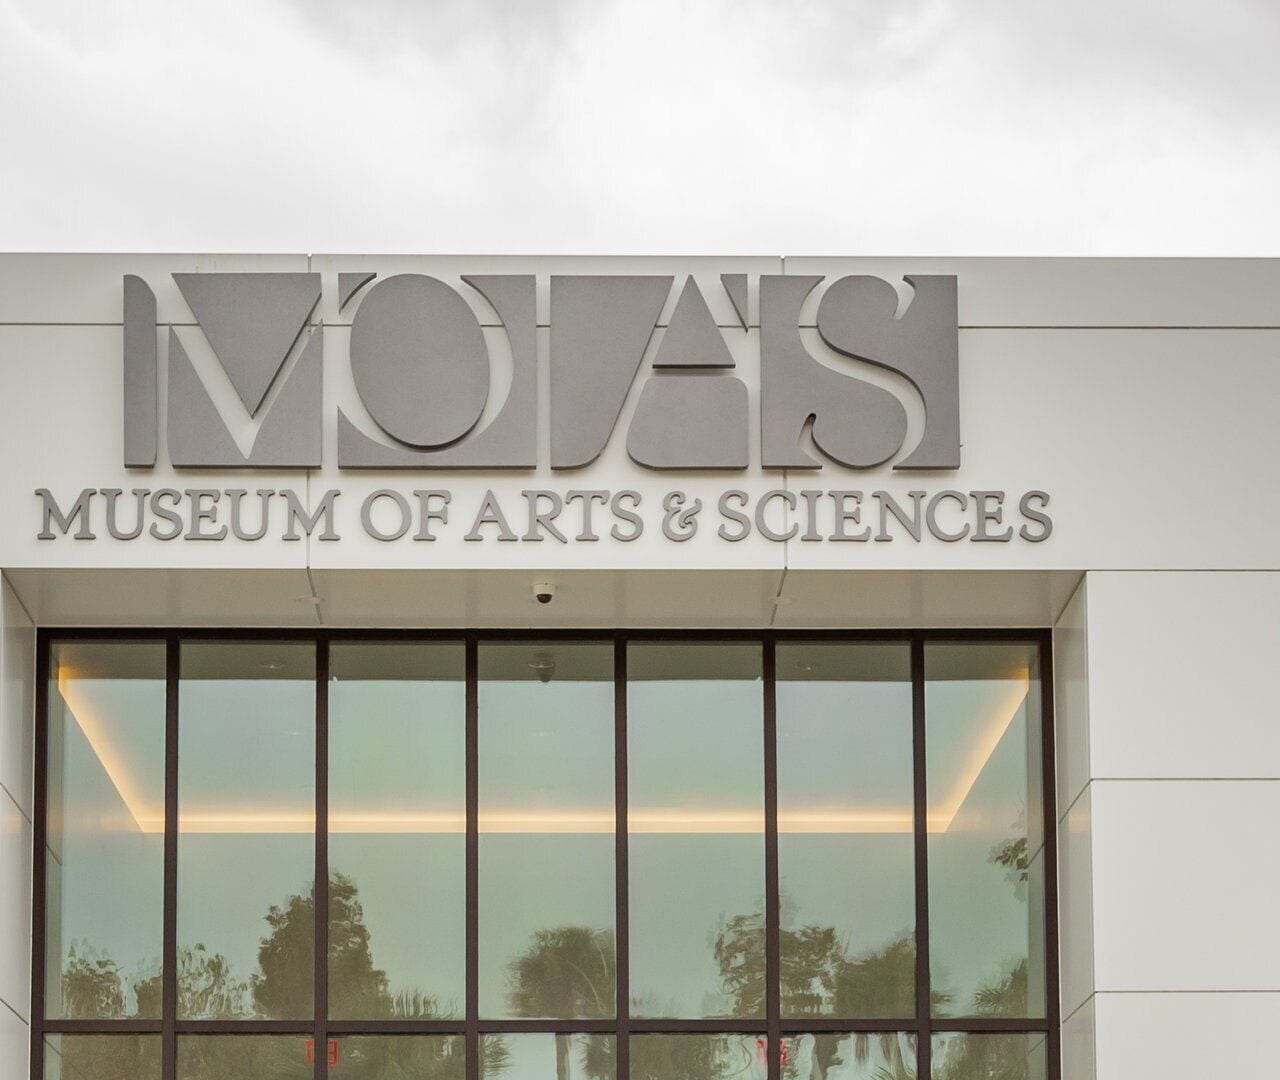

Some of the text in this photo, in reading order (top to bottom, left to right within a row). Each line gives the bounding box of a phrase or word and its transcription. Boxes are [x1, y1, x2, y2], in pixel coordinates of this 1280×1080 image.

[35, 488, 1054, 542] MUSEUM OF ARTS & SCIENCES
